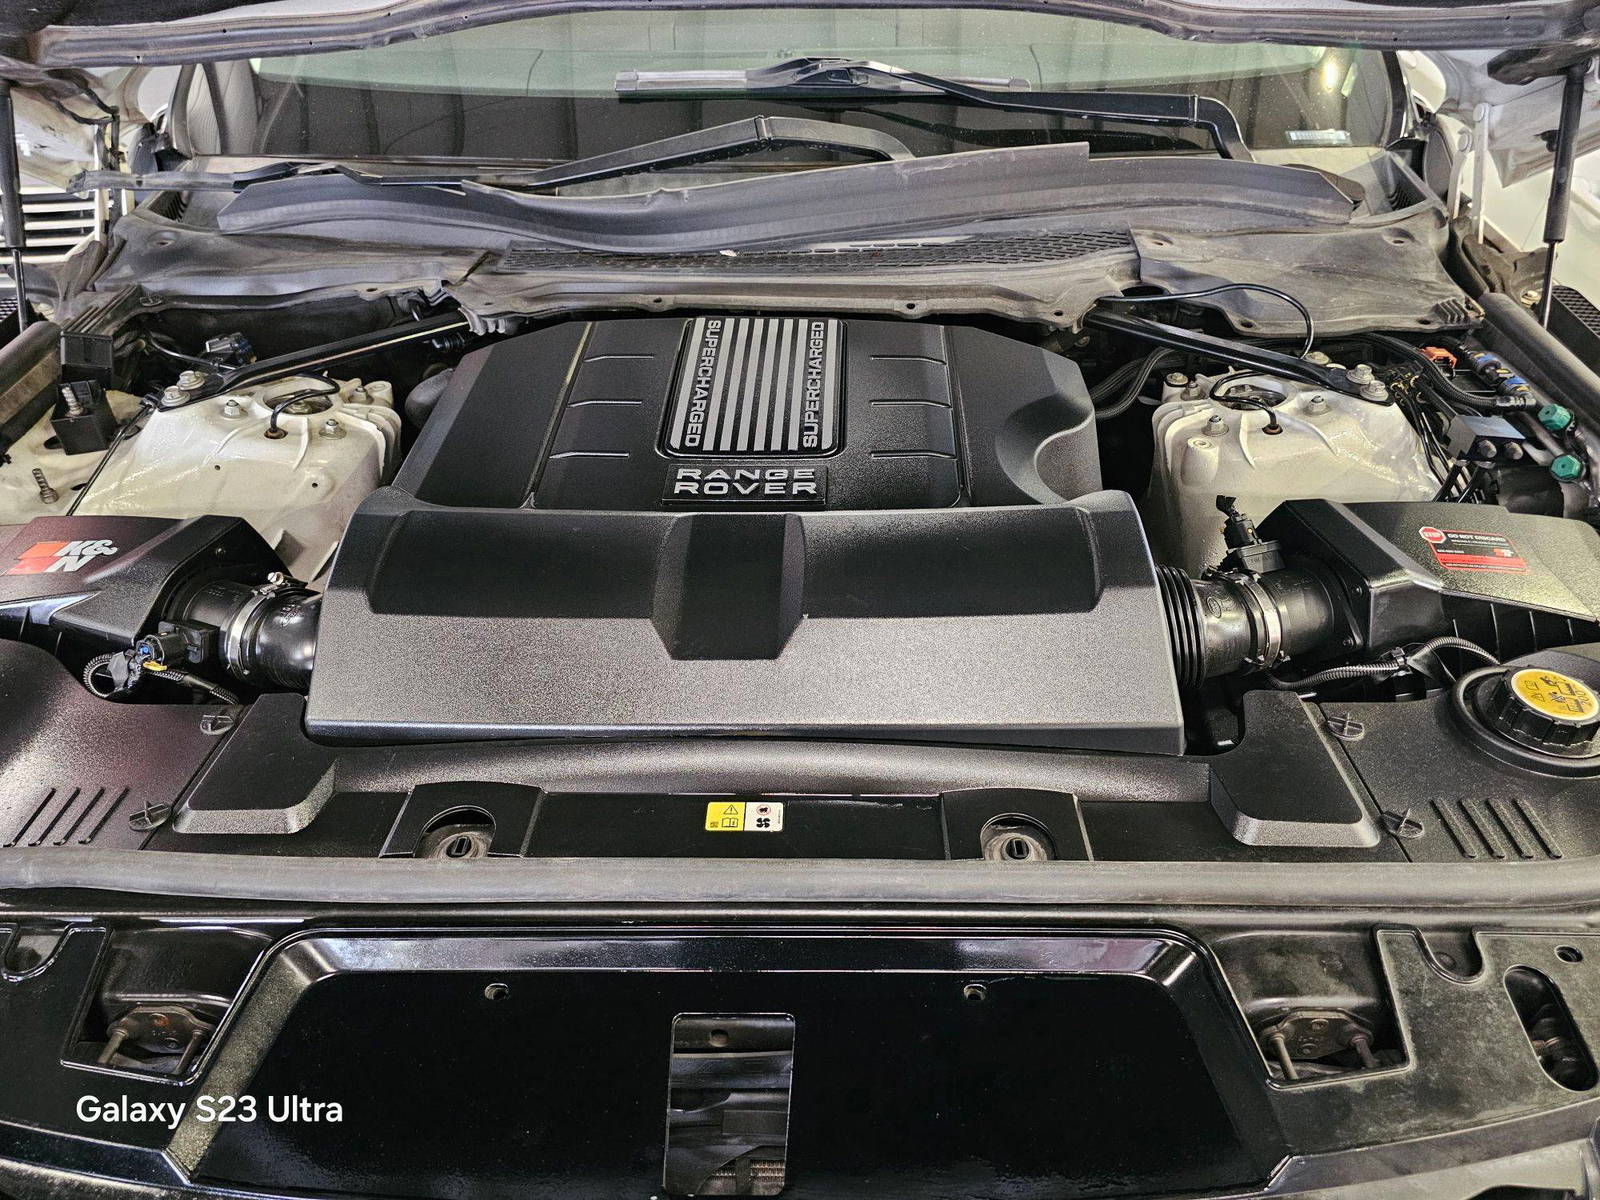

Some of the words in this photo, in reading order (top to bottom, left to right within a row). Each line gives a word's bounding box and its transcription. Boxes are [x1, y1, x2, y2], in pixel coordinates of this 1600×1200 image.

[685, 320, 721, 447] SUPERCHARGED
[803, 321, 825, 448] SUPERCHARGED
[673, 482, 817, 495] ROVER
[676, 468, 815, 480] RANGE
